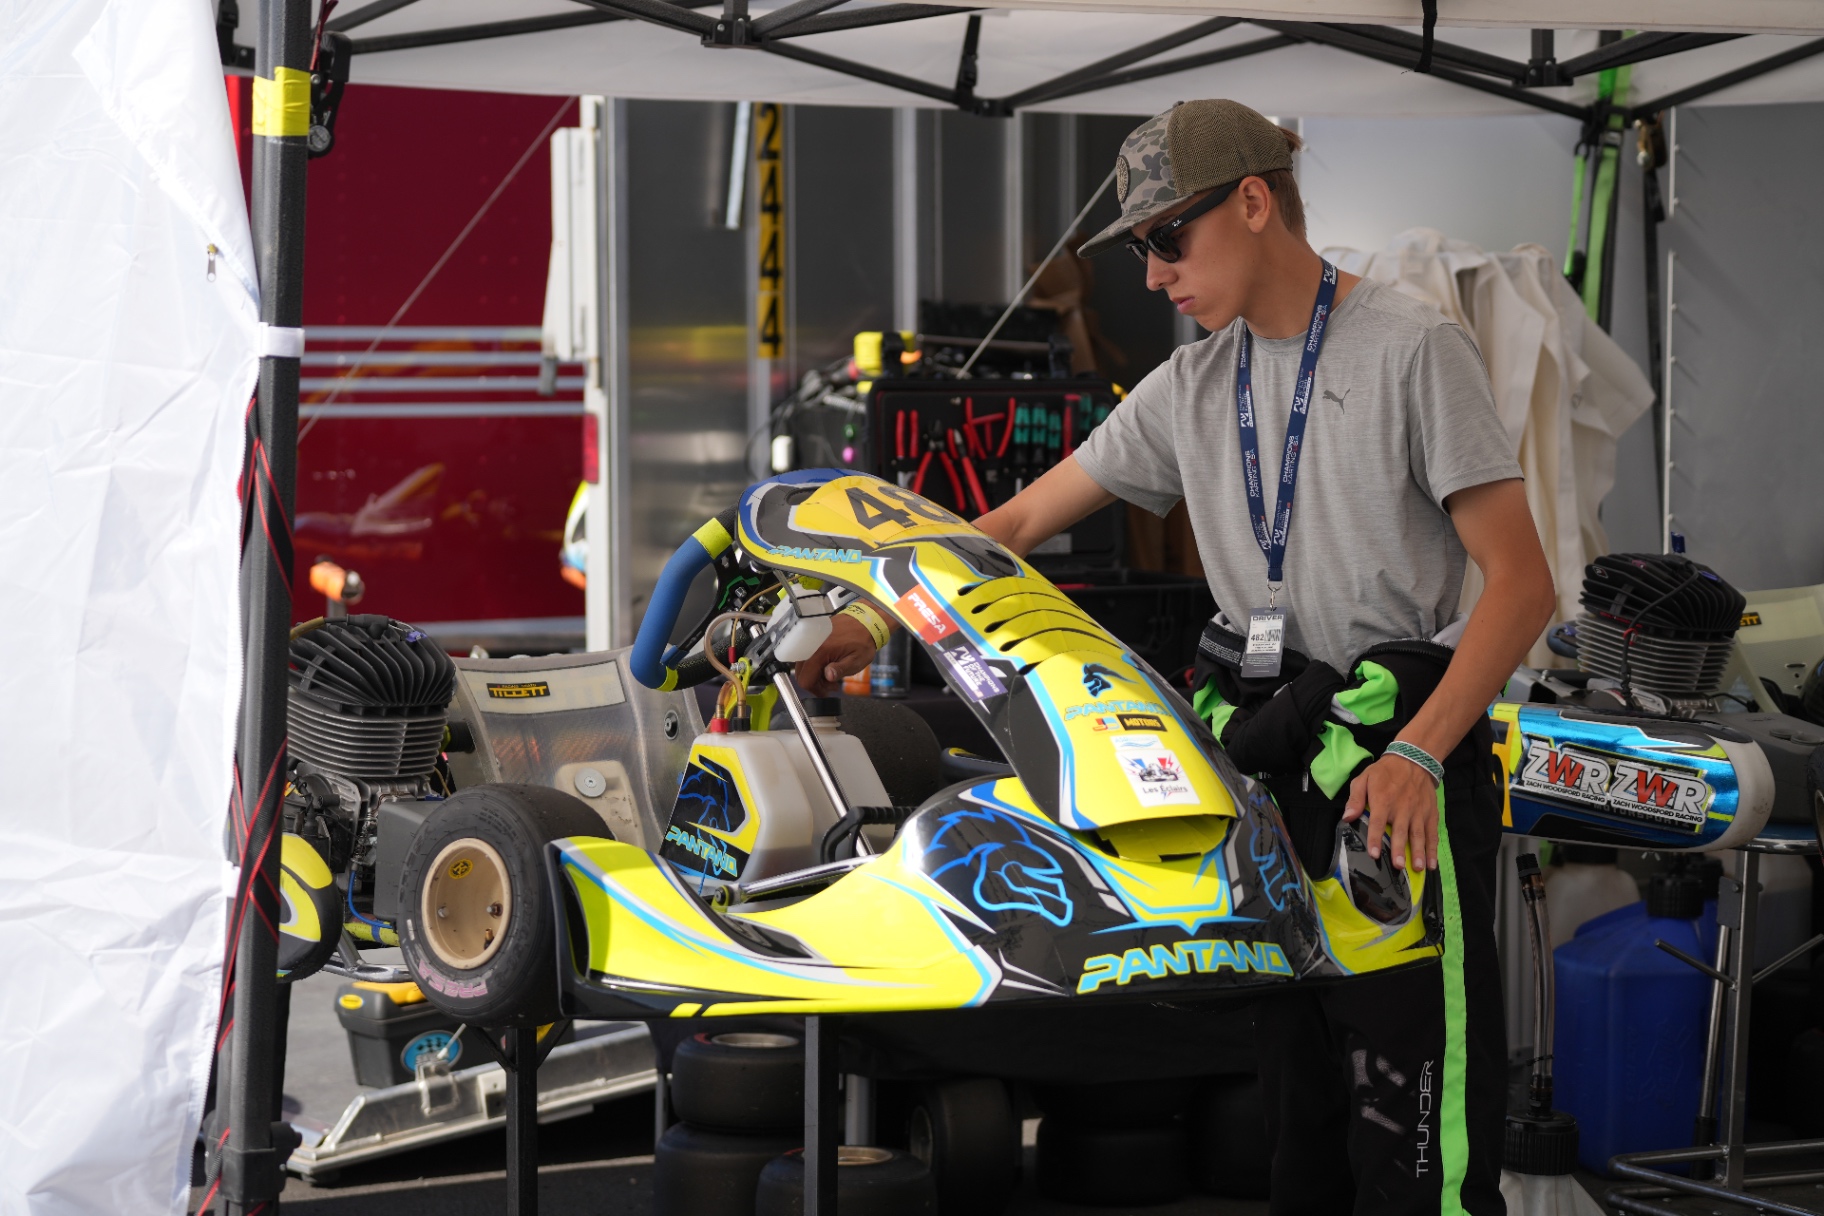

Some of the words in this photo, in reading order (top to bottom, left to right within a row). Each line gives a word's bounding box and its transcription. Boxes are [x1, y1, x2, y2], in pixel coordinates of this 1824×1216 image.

[1245, 450, 1255, 497] CHAMPIONS
[1283, 435, 1294, 483] CHAMPIONS
[844, 485, 962, 531] 48
[908, 593, 947, 634] PRESA
[1252, 614, 1283, 622] DRIVER
[489, 686, 547, 697] TILLETT
[973, 661, 1000, 693] CHAMPIONS
[1523, 746, 1609, 795] ZWR
[1526, 780, 1542, 788] ZACH
[1543, 783, 1580, 797] WOODSFORD
[1582, 792, 1605, 803] RACING
[1611, 765, 1706, 815] ZWR
[1613, 799, 1631, 809] ZACH
[1631, 802, 1674, 817] WOODSFORD
[1675, 812, 1703, 823] RACING
[1416, 1059, 1434, 1178] THUNDER
